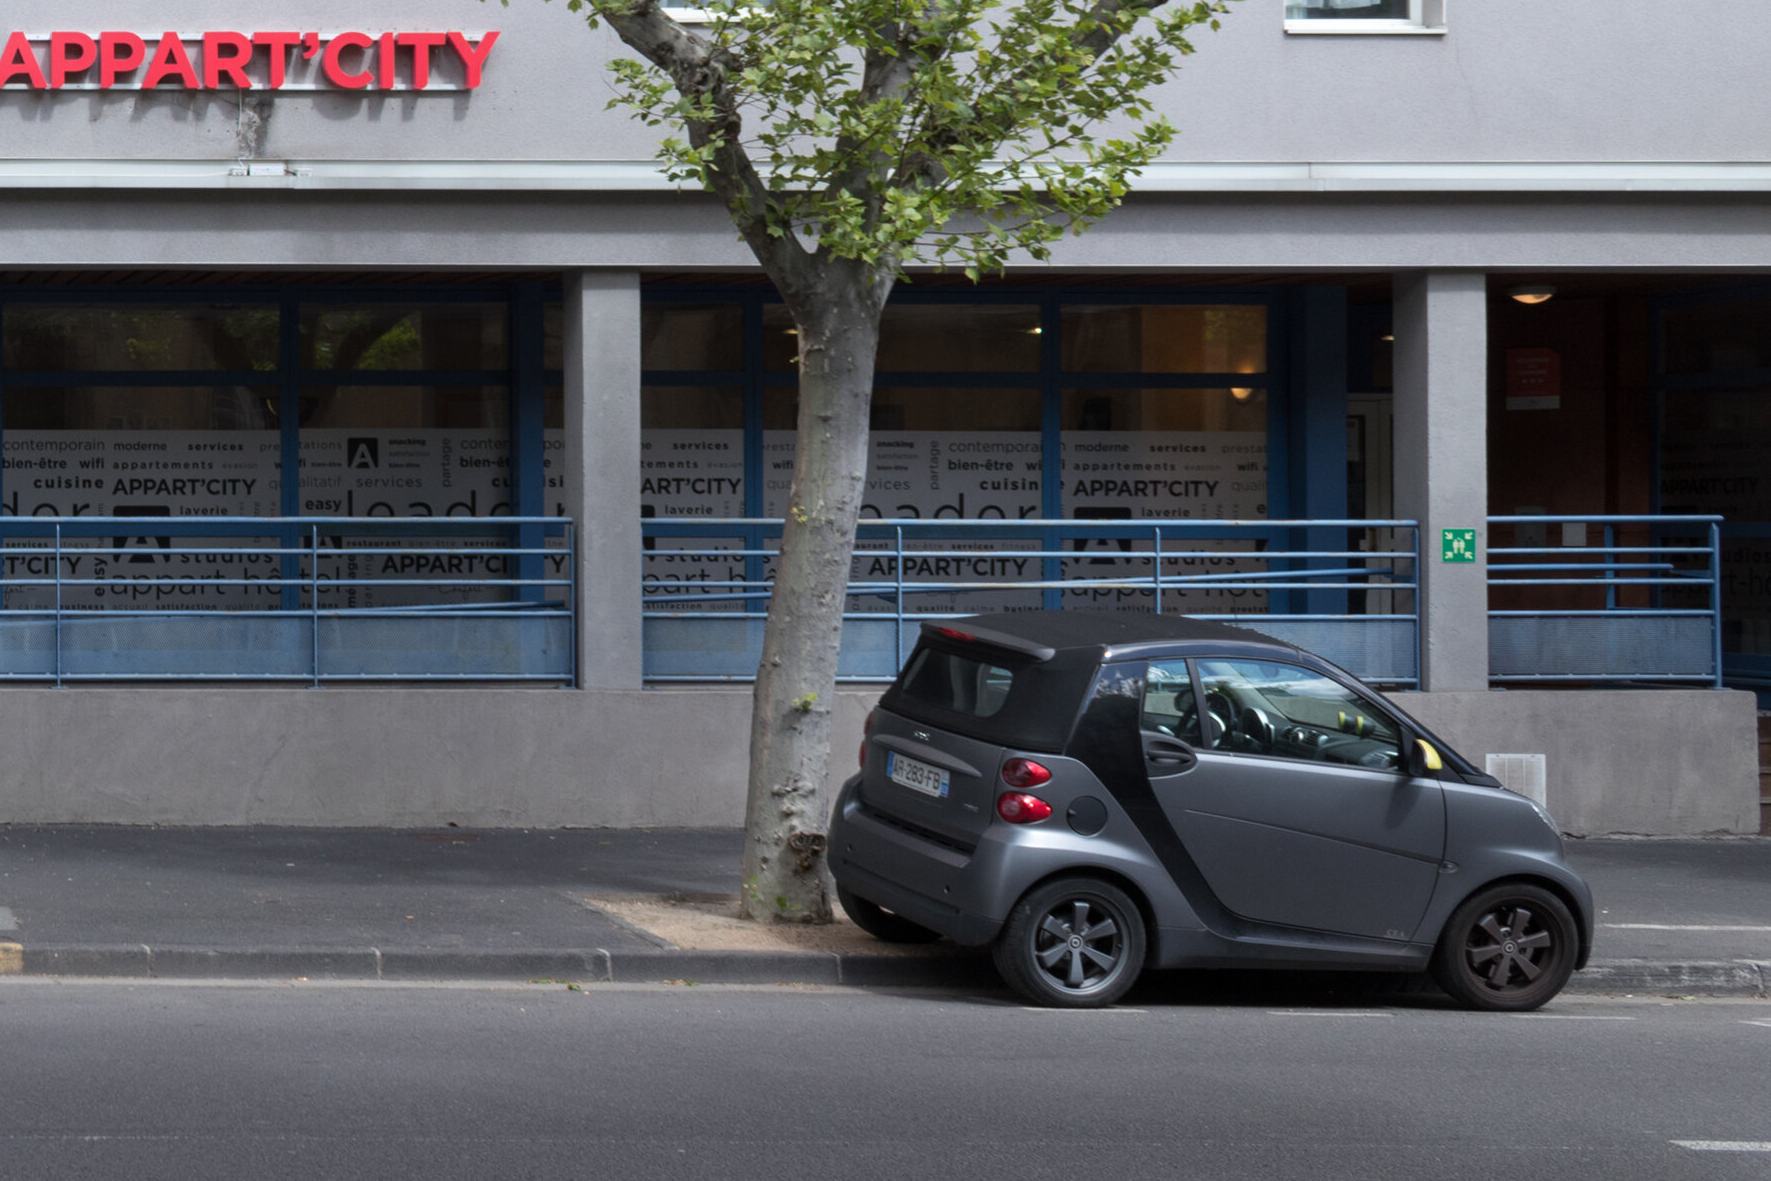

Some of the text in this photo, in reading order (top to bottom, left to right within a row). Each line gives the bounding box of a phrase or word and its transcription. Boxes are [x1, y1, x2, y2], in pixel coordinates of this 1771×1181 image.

[3, 439, 342, 453] contemporain moderne services pretations
[672, 441, 729, 450] services
[948, 442, 1066, 454] contemporan
[1075, 443, 1129, 452] moderne
[1149, 443, 1206, 453] services
[1222, 444, 1267, 454] prestat
[2, 458, 68, 469] bien-être
[79, 458, 104, 469] wifi
[113, 461, 213, 471] appartements
[274, 459, 306, 469] wfi
[442, 438, 452, 487] partage
[459, 457, 551, 468] bien-êe
[641, 460, 699, 469] tements
[930, 441, 941, 490] partage
[948, 459, 1013, 470] bien-être
[1026, 459, 1065, 470] wii
[1074, 463, 1176, 472] appartements
[1237, 462, 1258, 471] wifi
[33, 476, 104, 489] cuisine
[112, 478, 257, 495] APPART'CITY
[356, 476, 422, 488] services
[641, 477, 742, 494] ART'CITY
[866, 480, 910, 490] vices
[1073, 480, 1218, 497] APPART'CITY
[180, 506, 228, 515] laverie
[305, 499, 342, 512] easy
[665, 505, 713, 515] laverie
[1142, 507, 1190, 517] laverie
[6, 540, 48, 548] services
[951, 542, 994, 550] services
[1142, 550, 1236, 566] sudios
[1723, 547, 1771, 563] udios
[381, 555, 565, 573] APPART'CIY
[868, 558, 1028, 576] APPART'CITY
[348, 555, 358, 607] méage
[365, 554, 374, 607] paring
[1004, 604, 1043, 612] busine
[1230, 605, 1267, 613] prestat
